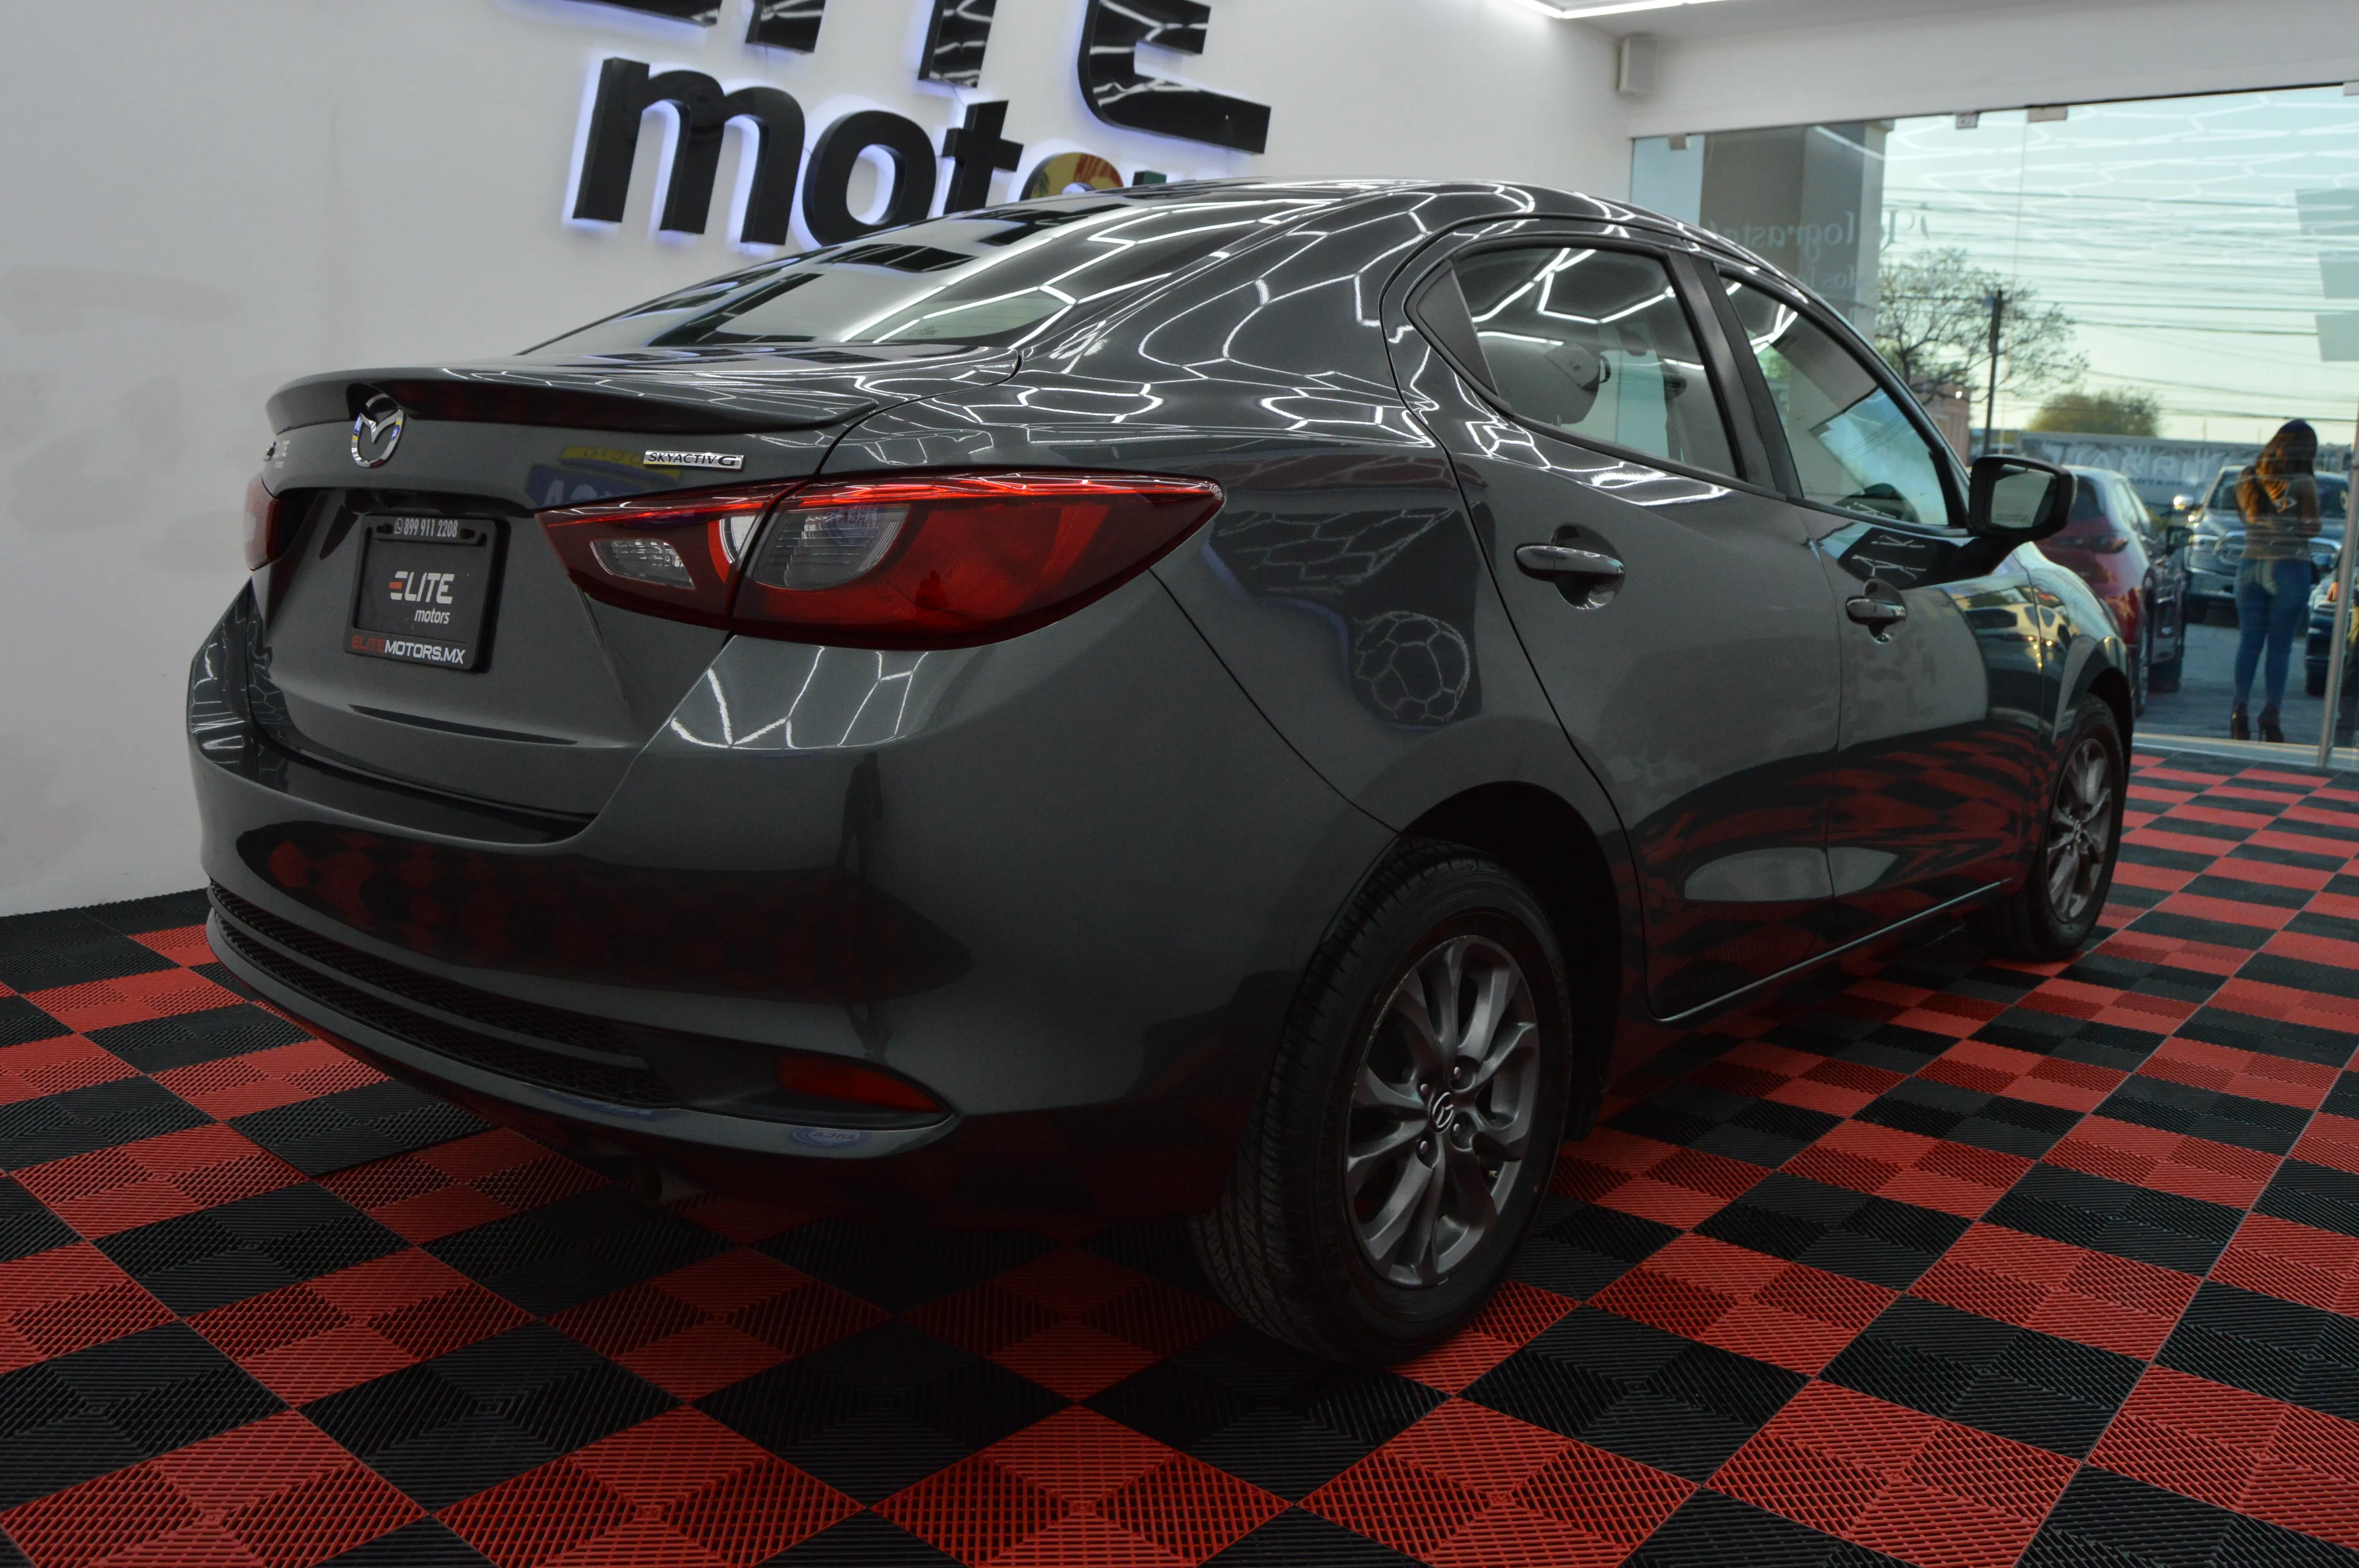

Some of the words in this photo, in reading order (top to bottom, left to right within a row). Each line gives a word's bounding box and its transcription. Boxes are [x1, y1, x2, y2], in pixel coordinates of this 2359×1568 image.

[404, 518, 419, 535] 899
[420, 519, 436, 536] 911
[437, 520, 458, 538] 2208
[389, 571, 455, 604] ELITE
[414, 608, 450, 624] motors
